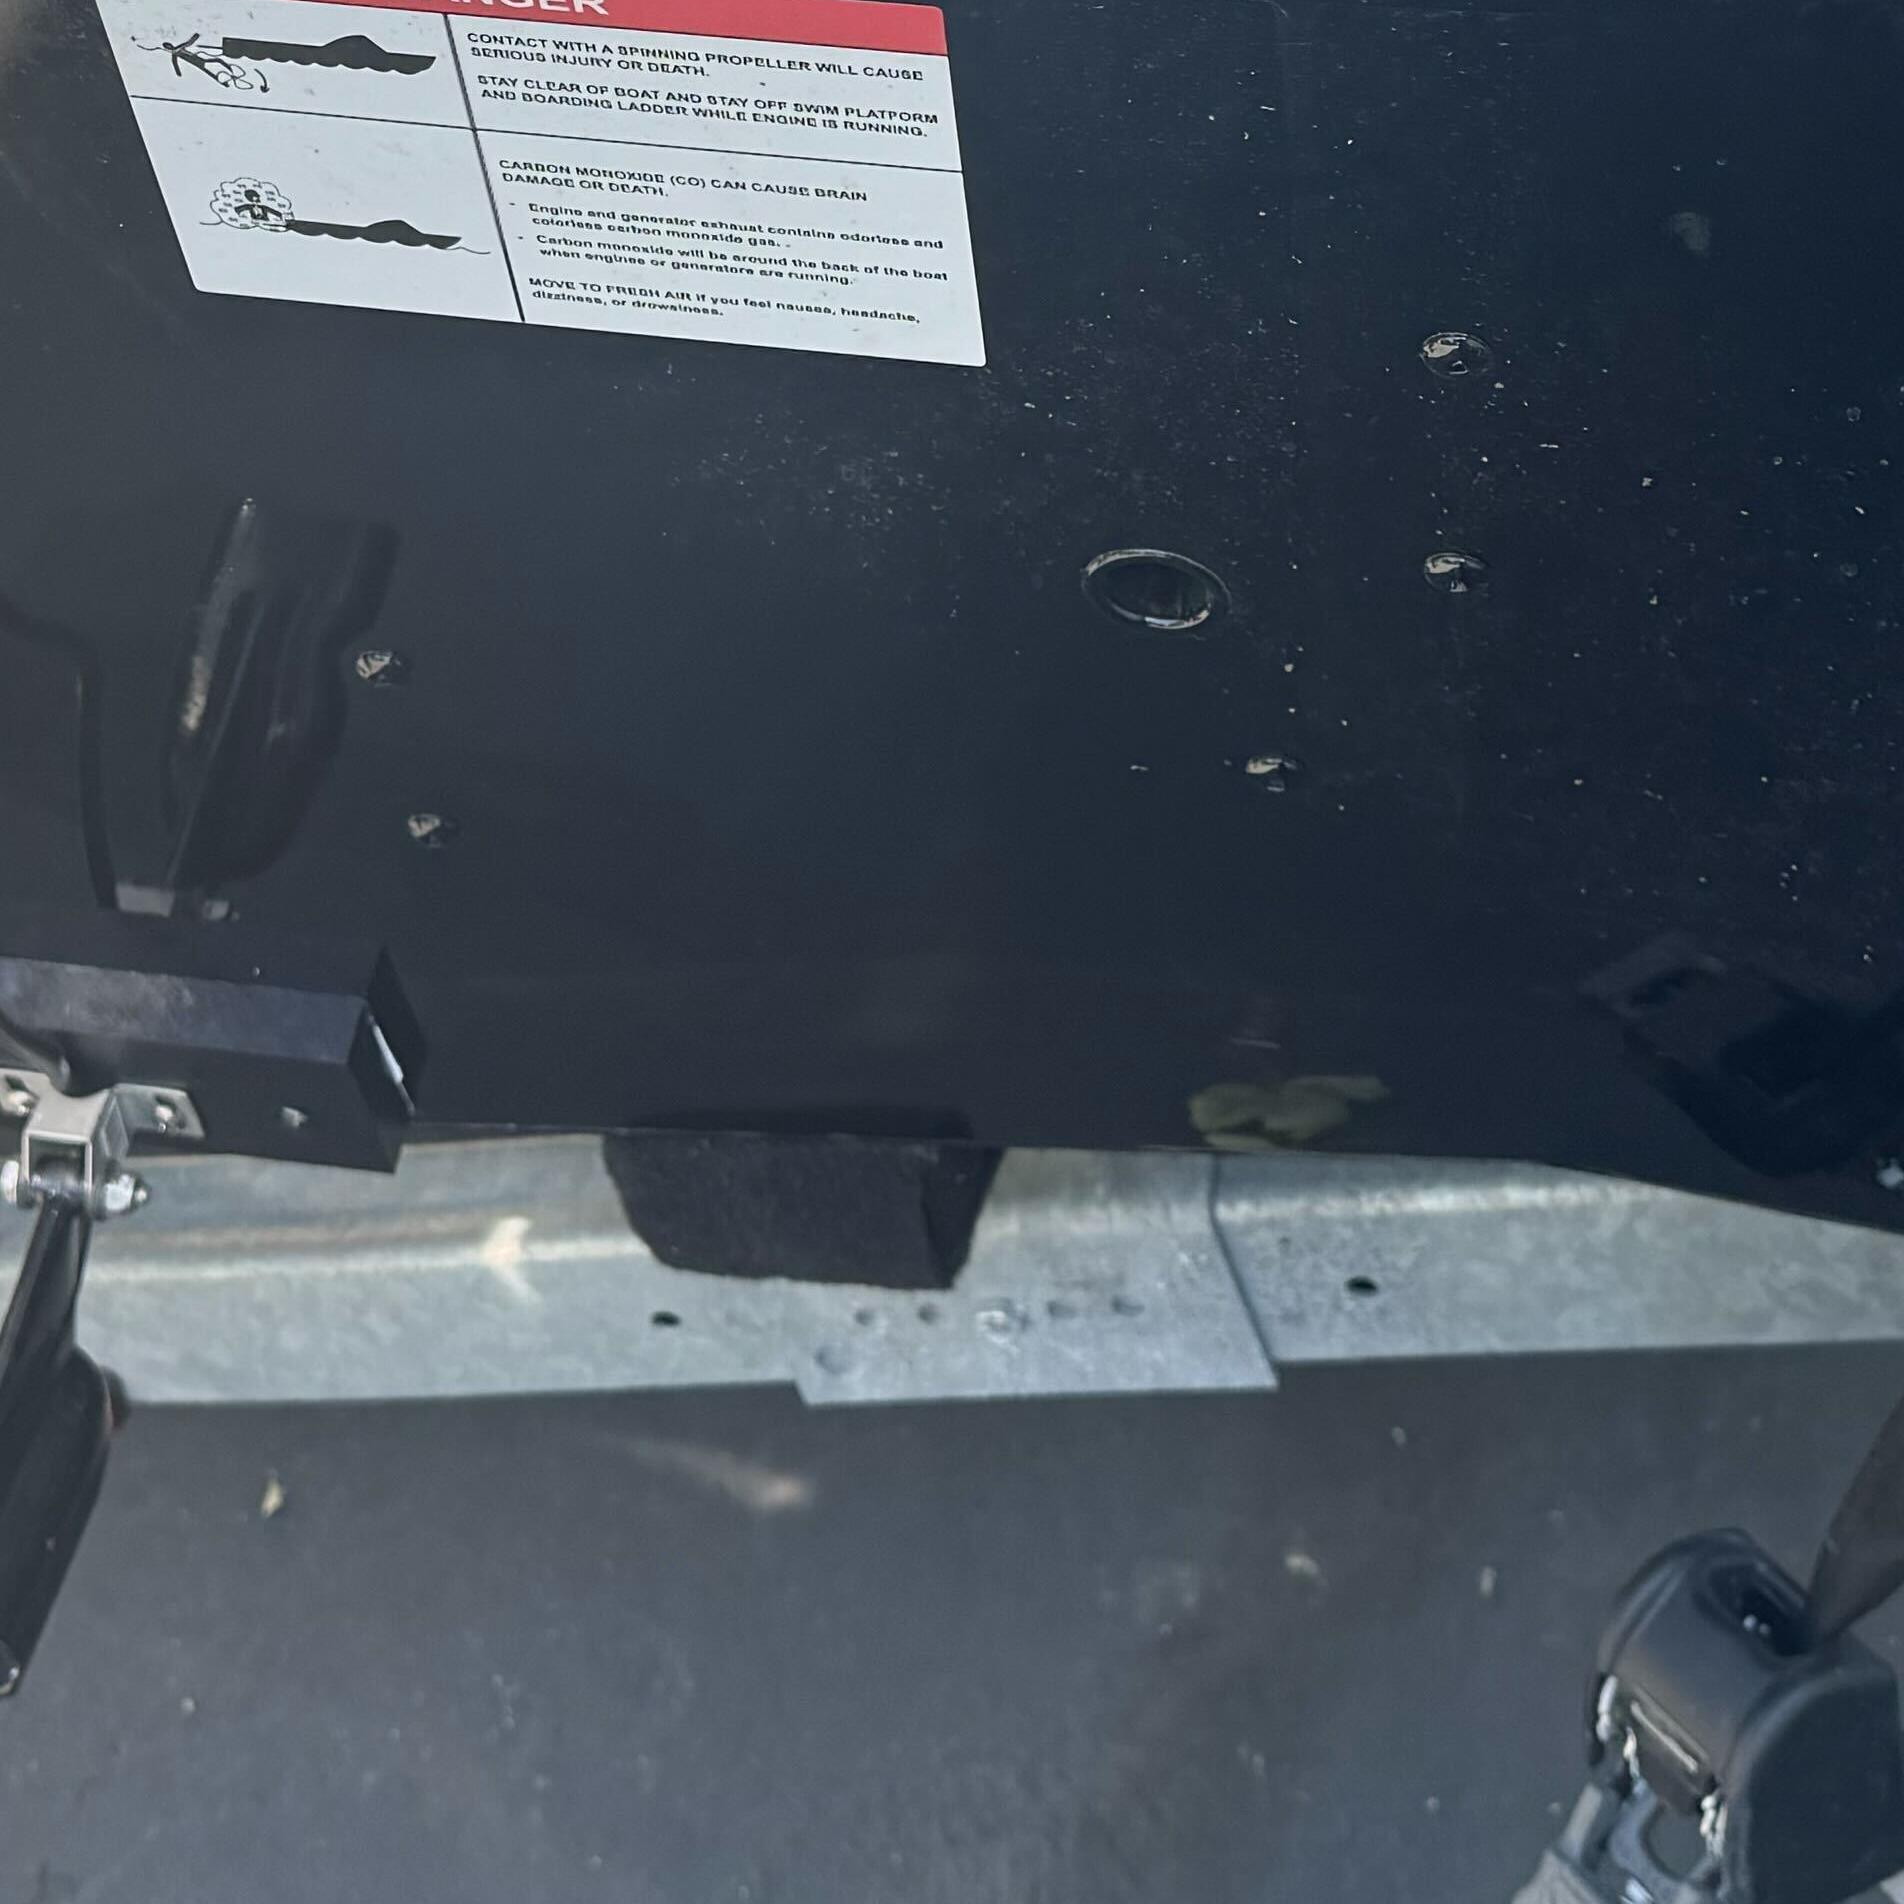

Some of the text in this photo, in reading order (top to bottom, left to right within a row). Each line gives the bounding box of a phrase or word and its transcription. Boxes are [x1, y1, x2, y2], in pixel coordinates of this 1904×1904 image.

[465, 31, 924, 81] CONTACT WITH A SPINNING PROPELLER WILL CAUSE
[469, 45, 710, 77] SERIOUS INJURY OR DEATH.
[476, 73, 939, 125] STAY CLEAR OF BOAT AND STAY OFF SWIM PLATFORM
[480, 88, 928, 138] AND BOARDING LADDER WHILE ENGINE IS RUNNING.
[497, 158, 868, 202] CARBON MONOXIDE (CO) CAN CAUSE BRAIN
[500, 171, 669, 197] DAMAGE OR DEATH.
[527, 201, 583, 217] Engine
[586, 209, 616, 220] and
[699, 219, 765, 234] exhaust
[766, 225, 836, 240] contains
[838, 232, 910, 246] odorless
[912, 239, 944, 250] and
[606, 223, 662, 237] carbon
[664, 228, 744, 244] monoxide
[746, 236, 781, 248] gas.
[535, 233, 948, 282] Carbon monoxide will be around the back of the boat
[538, 246, 581, 259] when
[583, 251, 646, 266] engines
[649, 258, 667, 267] or
[757, 268, 784, 278] are
[786, 270, 855, 286] running.
[527, 276, 576, 291] MOVE
[577, 281, 602, 293] TO
[604, 283, 661, 298] FRESH
[663, 289, 692, 302] AIR
[694, 292, 706, 303] if
[709, 295, 740, 306] you
[742, 296, 772, 309] feel
[774, 301, 837, 316] nausea,
[609, 298, 627, 307] or
